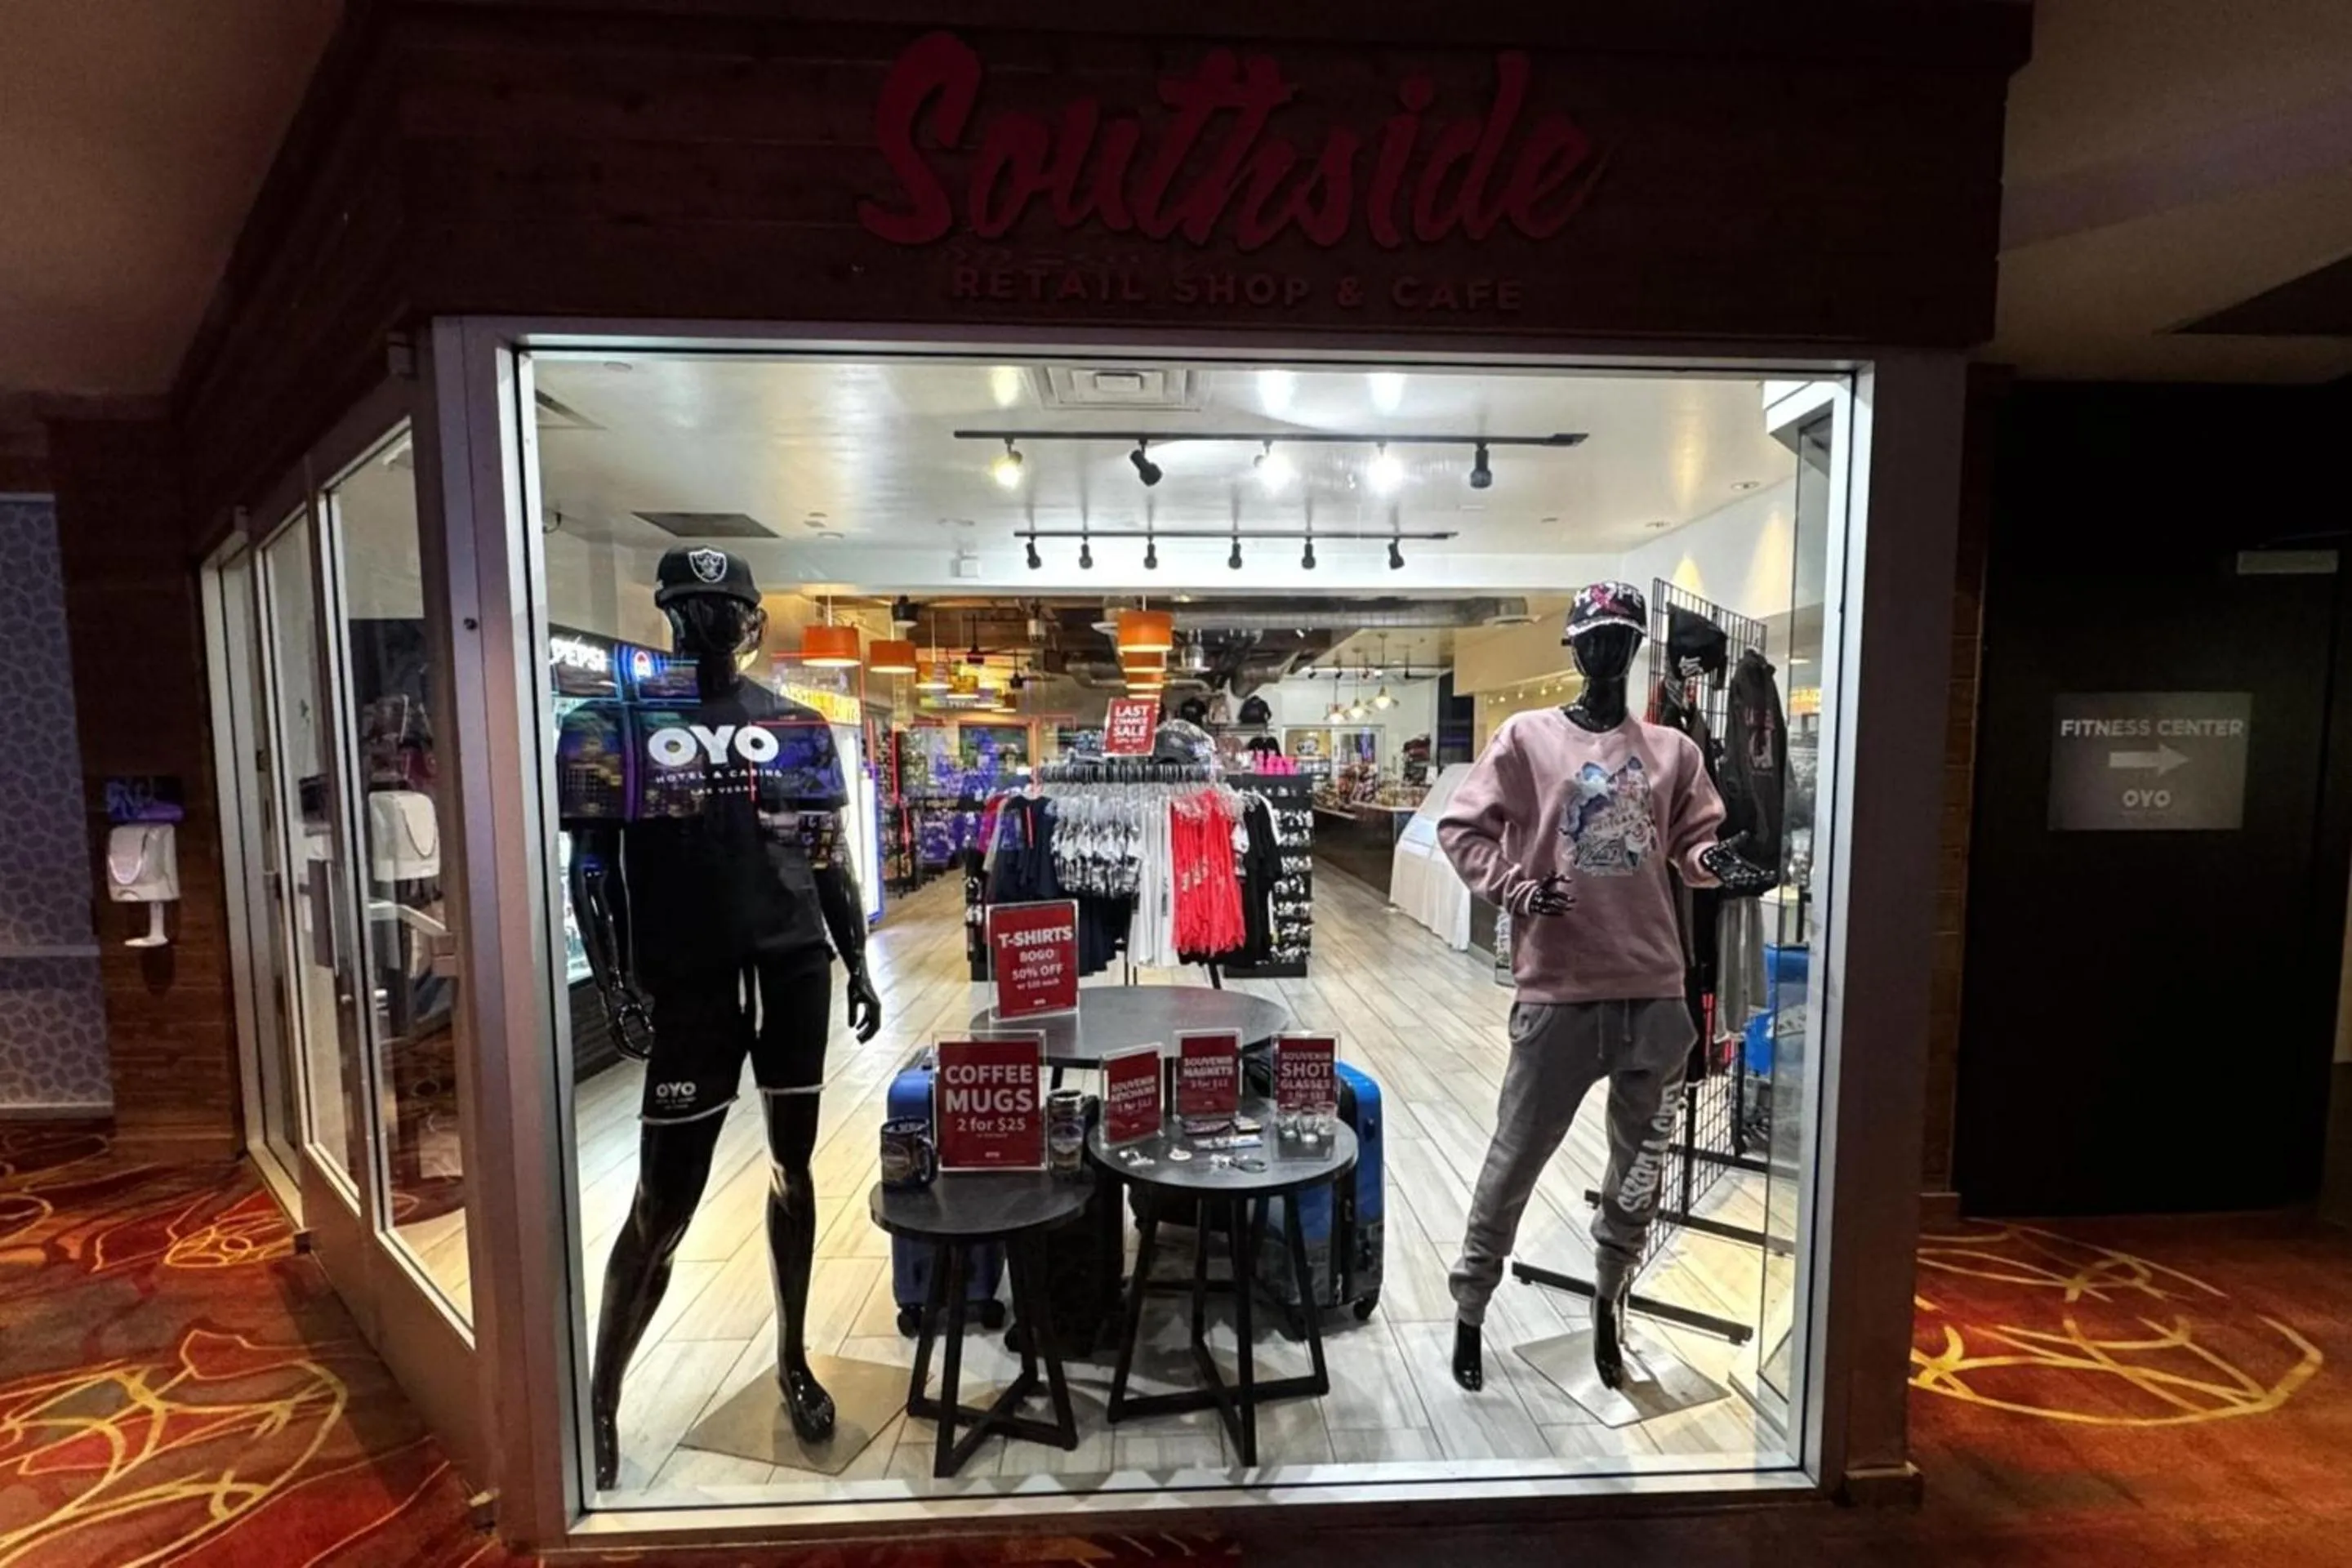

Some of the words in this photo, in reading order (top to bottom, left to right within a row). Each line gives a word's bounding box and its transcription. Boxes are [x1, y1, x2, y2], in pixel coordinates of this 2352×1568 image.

[856, 31, 1606, 250] Southside
[953, 269, 1146, 302] RETAIL
[1173, 273, 1309, 305] SHOP
[1338, 277, 1365, 309] &
[1393, 277, 1522, 311] CAFE
[1115, 704, 1149, 717] LAST
[1113, 724, 1147, 737] SALE
[2060, 719, 2151, 737] FITNESS
[2157, 719, 2244, 737] CENTER
[648, 724, 780, 766] OYO
[656, 770, 706, 783] HOTEL
[2123, 790, 2172, 808] OYO
[997, 925, 1073, 948] T-SHIRTS
[1019, 949, 1055, 963] BOGO
[1012, 967, 1038, 980] 50%
[1040, 964, 1063, 976] OFF
[945, 1064, 1033, 1084] COFFEE
[1183, 1067, 1234, 1077] MAGNETS
[1281, 1062, 1331, 1077] SHOT
[656, 1081, 697, 1098] OYO
[1280, 1078, 1330, 1089] GLASSES
[945, 1089, 1033, 1113] MUGS
[956, 1118, 967, 1131] 2
[970, 1117, 994, 1131] for
[996, 1116, 1026, 1131] $25
